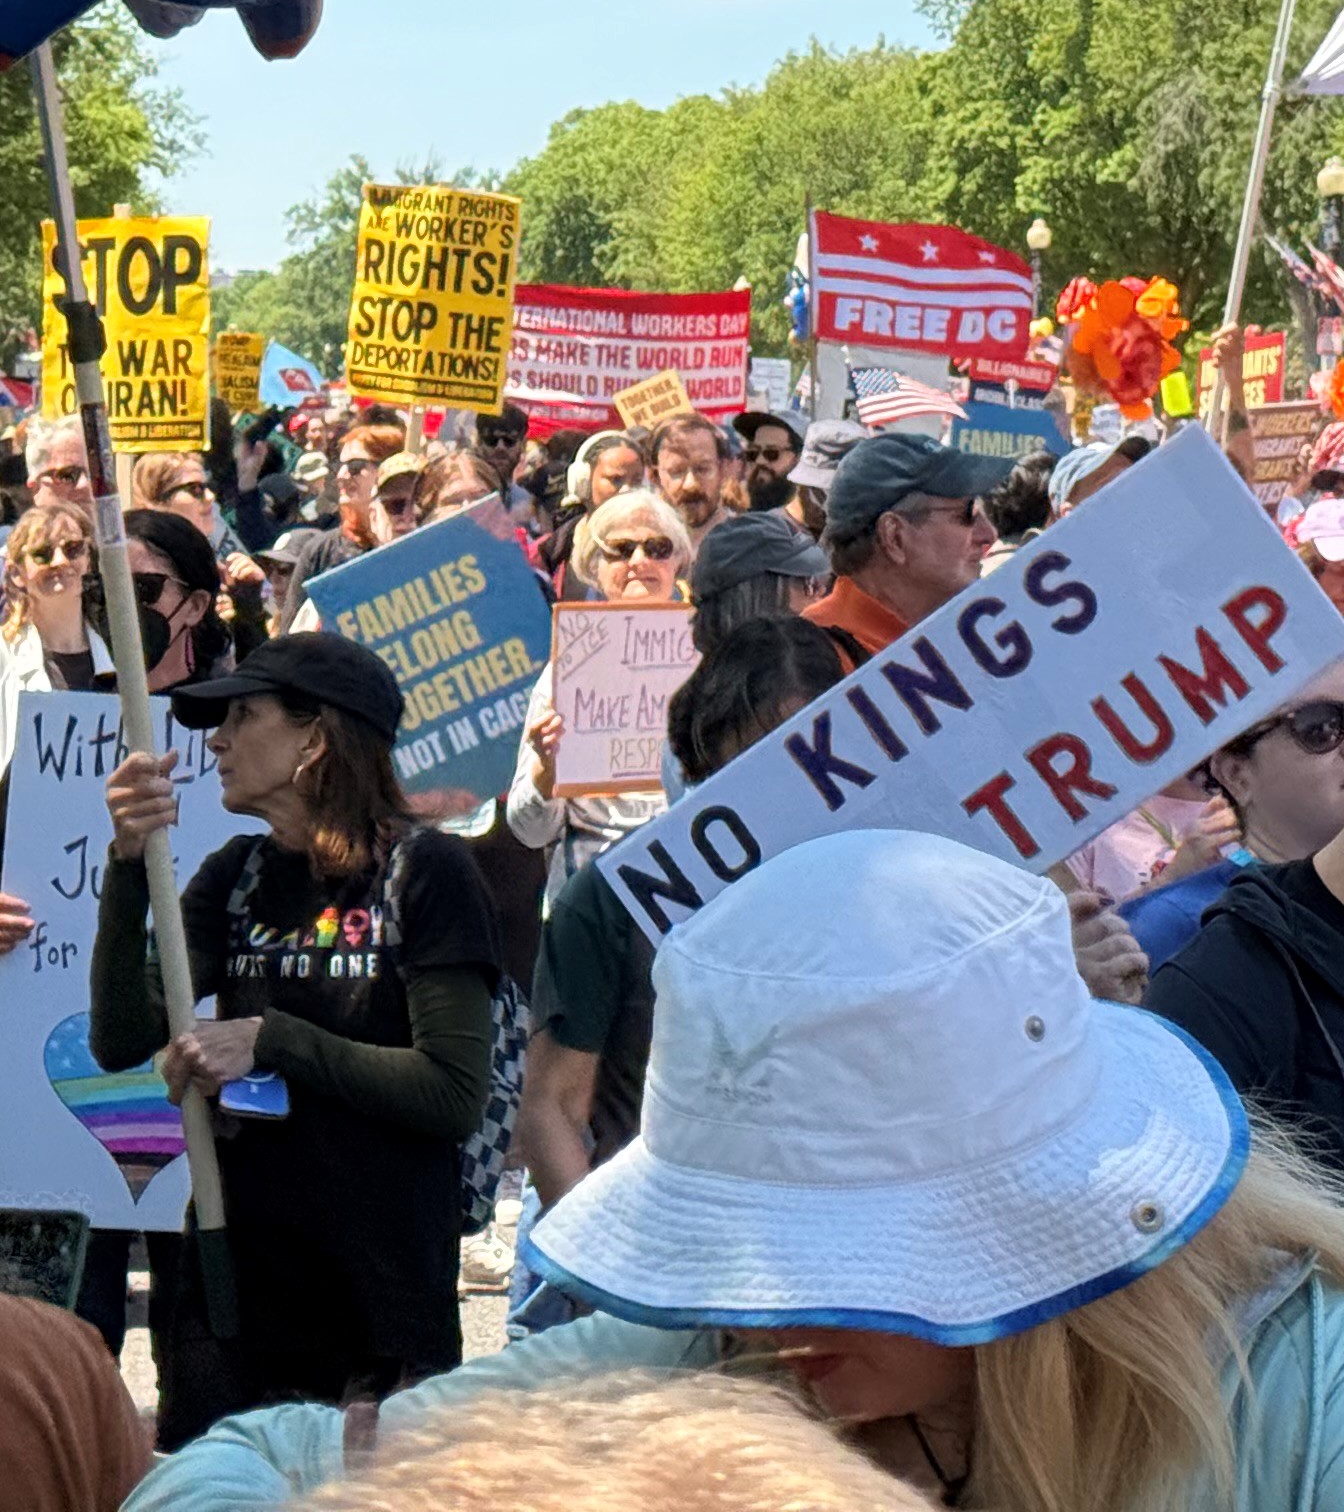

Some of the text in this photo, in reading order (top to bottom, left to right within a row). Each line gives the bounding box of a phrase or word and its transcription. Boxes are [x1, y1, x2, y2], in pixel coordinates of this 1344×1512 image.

[394, 211, 515, 250] WORKER'S
[457, 197, 515, 222] RIGHTS
[363, 237, 511, 298] RIGHTS!
[354, 295, 439, 346] STOP
[448, 311, 505, 354] THE
[513, 305, 748, 338] TERNATIONAL WORKERS DAY
[833, 296, 1017, 344] FREE DC
[117, 338, 193, 377] WAR
[351, 340, 500, 382] DEPORTATIONS!
[535, 338, 594, 367] MAKE
[594, 342, 632, 370] THE
[636, 345, 706, 370] WORLD
[708, 343, 744, 368] RUN
[108, 378, 189, 418] IRAN!
[526, 370, 599, 398] SHOULD
[685, 376, 742, 400] WORLD
[957, 427, 1047, 457] FAMILIES
[336, 553, 487, 646] FAMILIES
[375, 609, 483, 684] ELONG
[620, 615, 695, 665] IMMIG
[401, 636, 543, 731] OGETHER.
[573, 686, 632, 730] MAKE
[961, 583, 1291, 861] TRUMP
[393, 730, 447, 780] NOT
[445, 715, 480, 755] IN
[609, 737, 662, 773] RESP
[612, 550, 1100, 936] NO KINGS
[28, 920, 78, 973] for
[279, 953, 311, 979] NO
[328, 952, 380, 979] ONE
